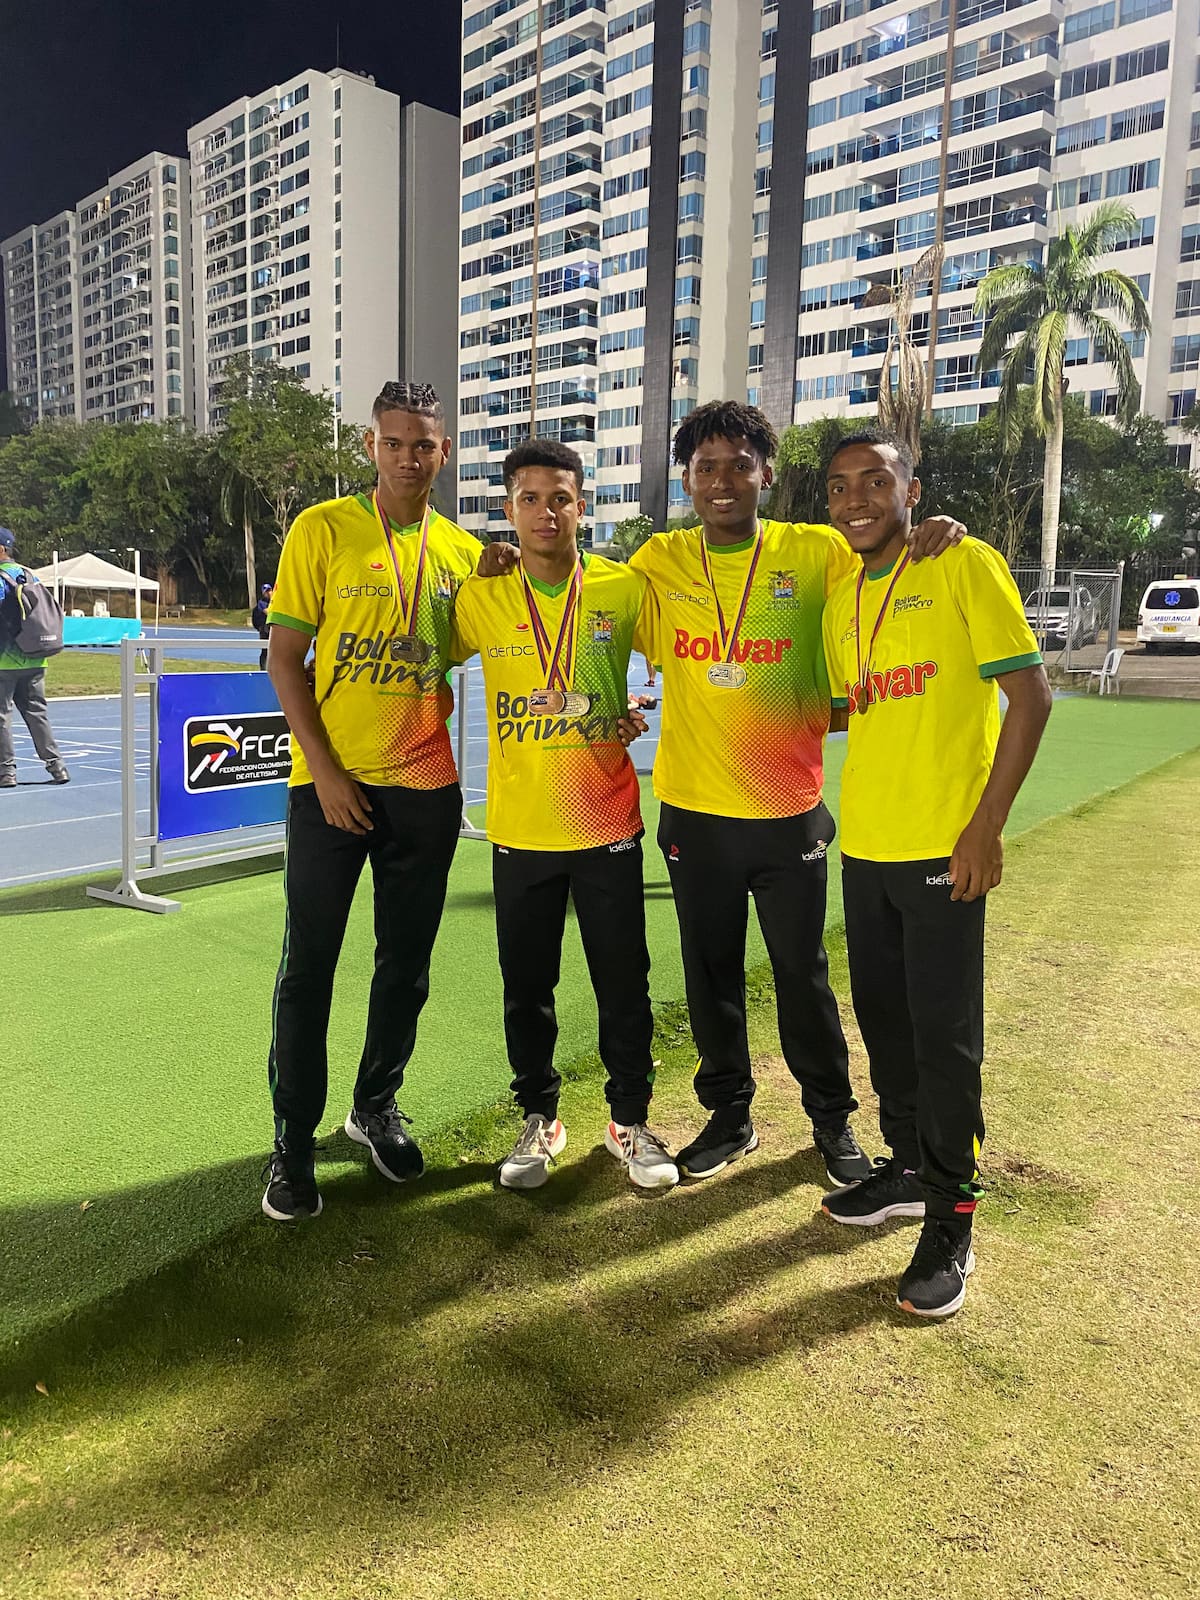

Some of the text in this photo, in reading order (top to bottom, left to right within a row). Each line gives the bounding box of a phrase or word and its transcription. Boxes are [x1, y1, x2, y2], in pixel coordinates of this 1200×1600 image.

[242, 733, 291, 760] FCA
[219, 760, 292, 774] FEDERACION COLOMBIAN
[245, 769, 279, 779] ATLETISMO
